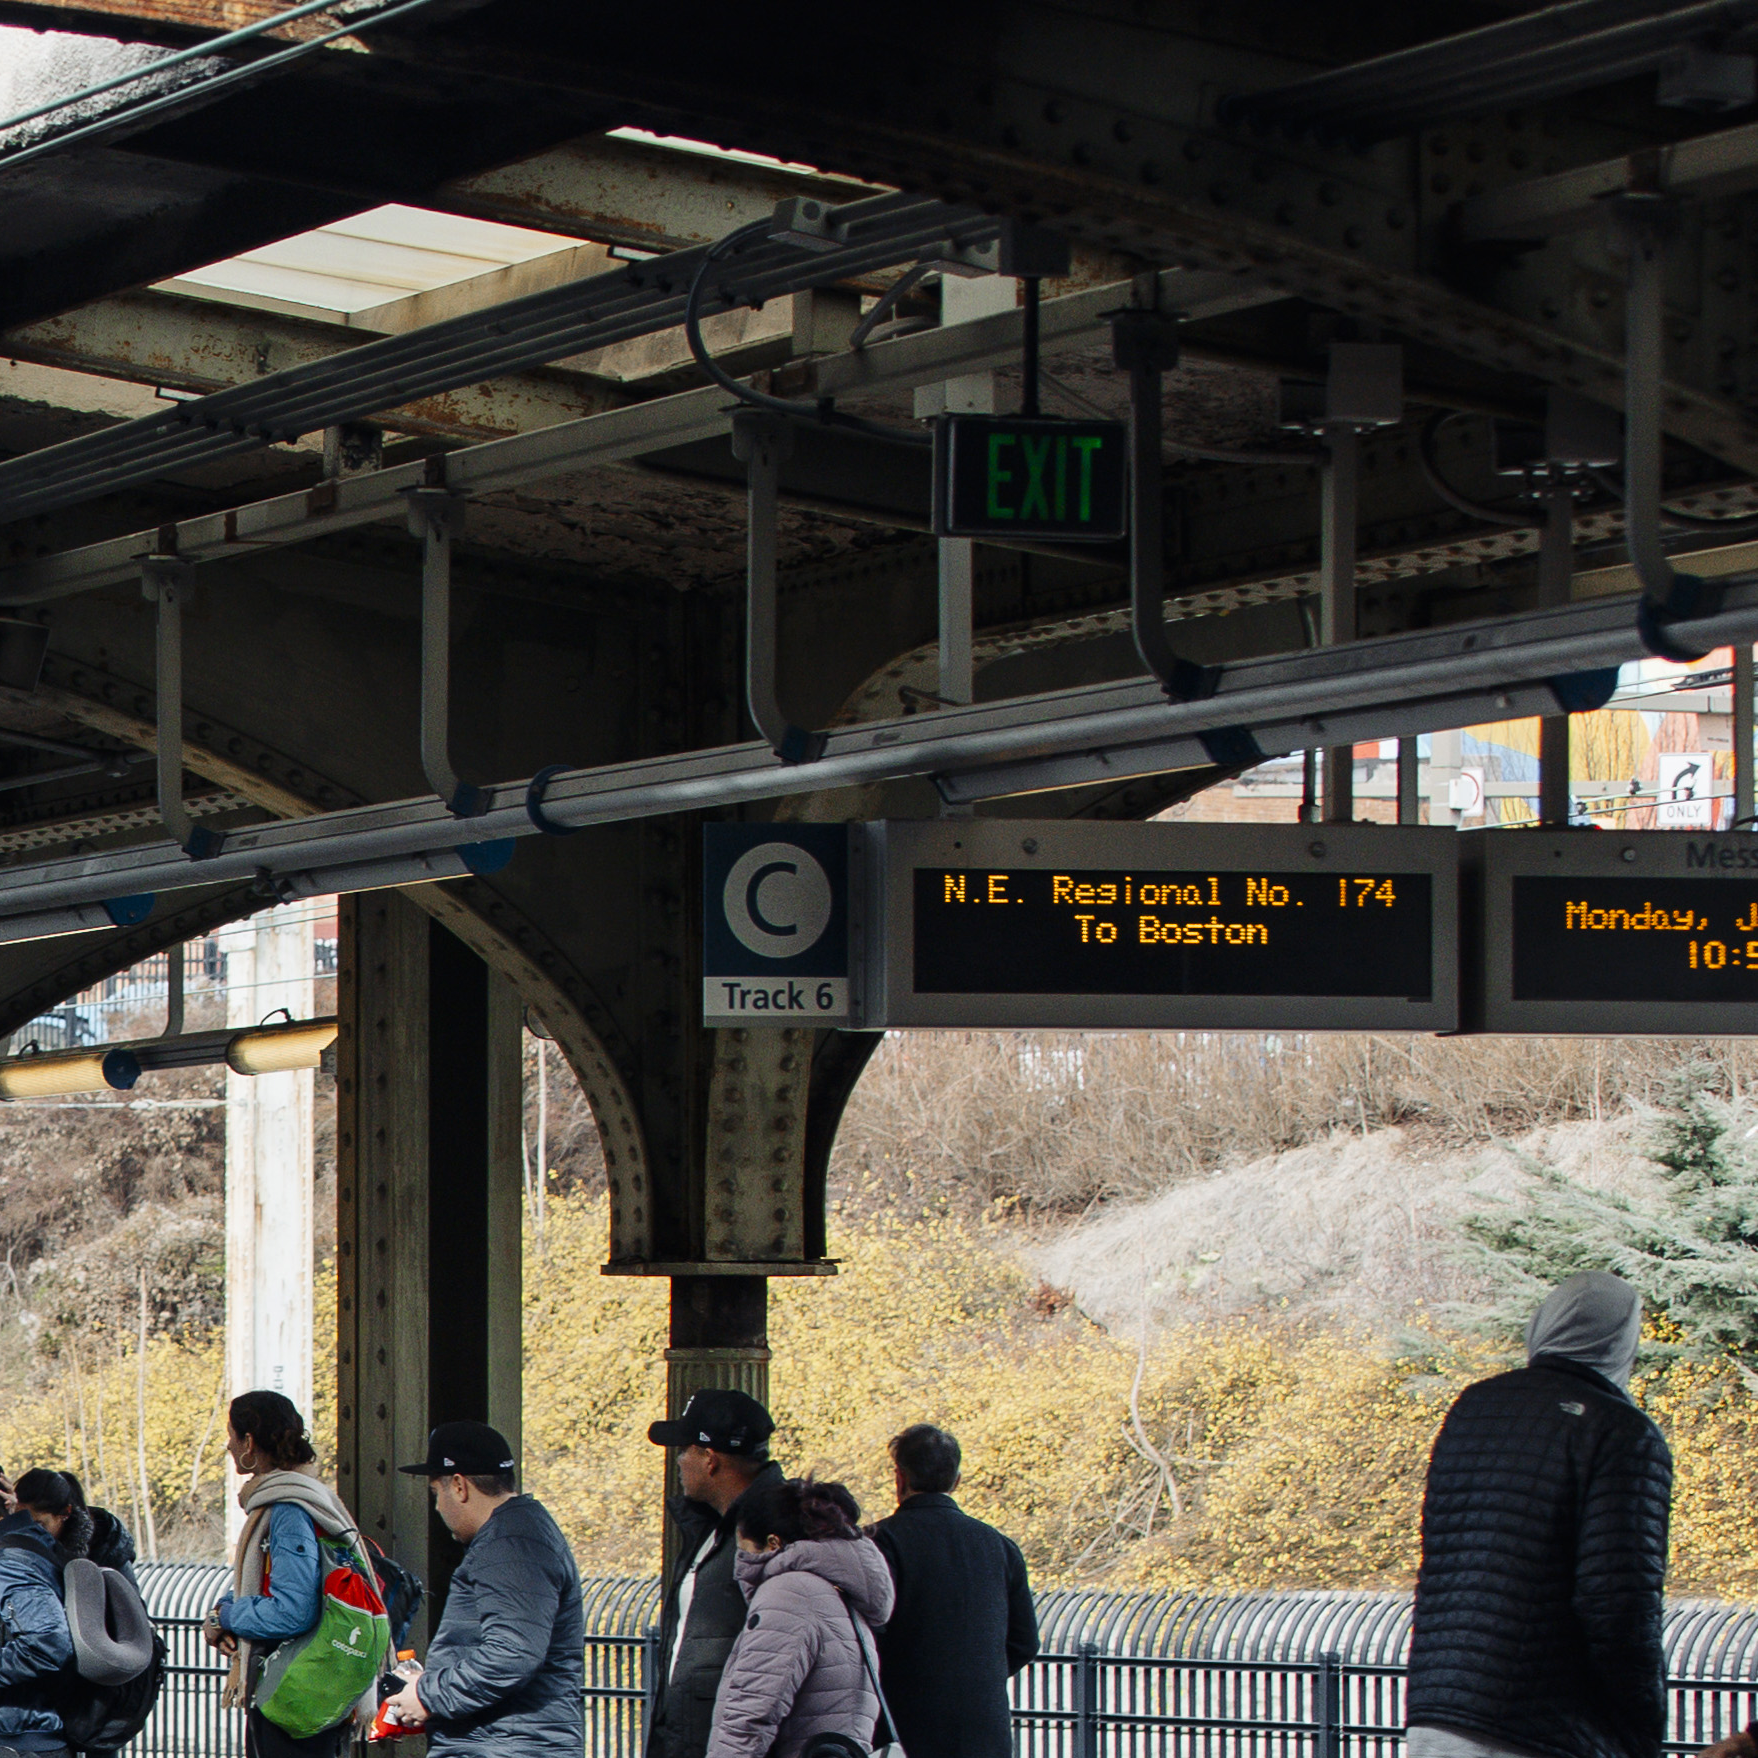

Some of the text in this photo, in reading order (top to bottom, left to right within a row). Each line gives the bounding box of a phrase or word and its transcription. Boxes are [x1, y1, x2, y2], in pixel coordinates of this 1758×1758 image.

[986, 433, 1103, 522] EXIT
[1666, 805, 1702, 818] ONLY
[746, 861, 797, 936] C
[944, 875, 1397, 907] N.E. Regional No. 174
[1074, 914, 1268, 945] To Boston
[1566, 901, 1708, 931] Monday,
[722, 980, 833, 1010] Track 6
[331, 1639, 367, 1659] cotopaxi
